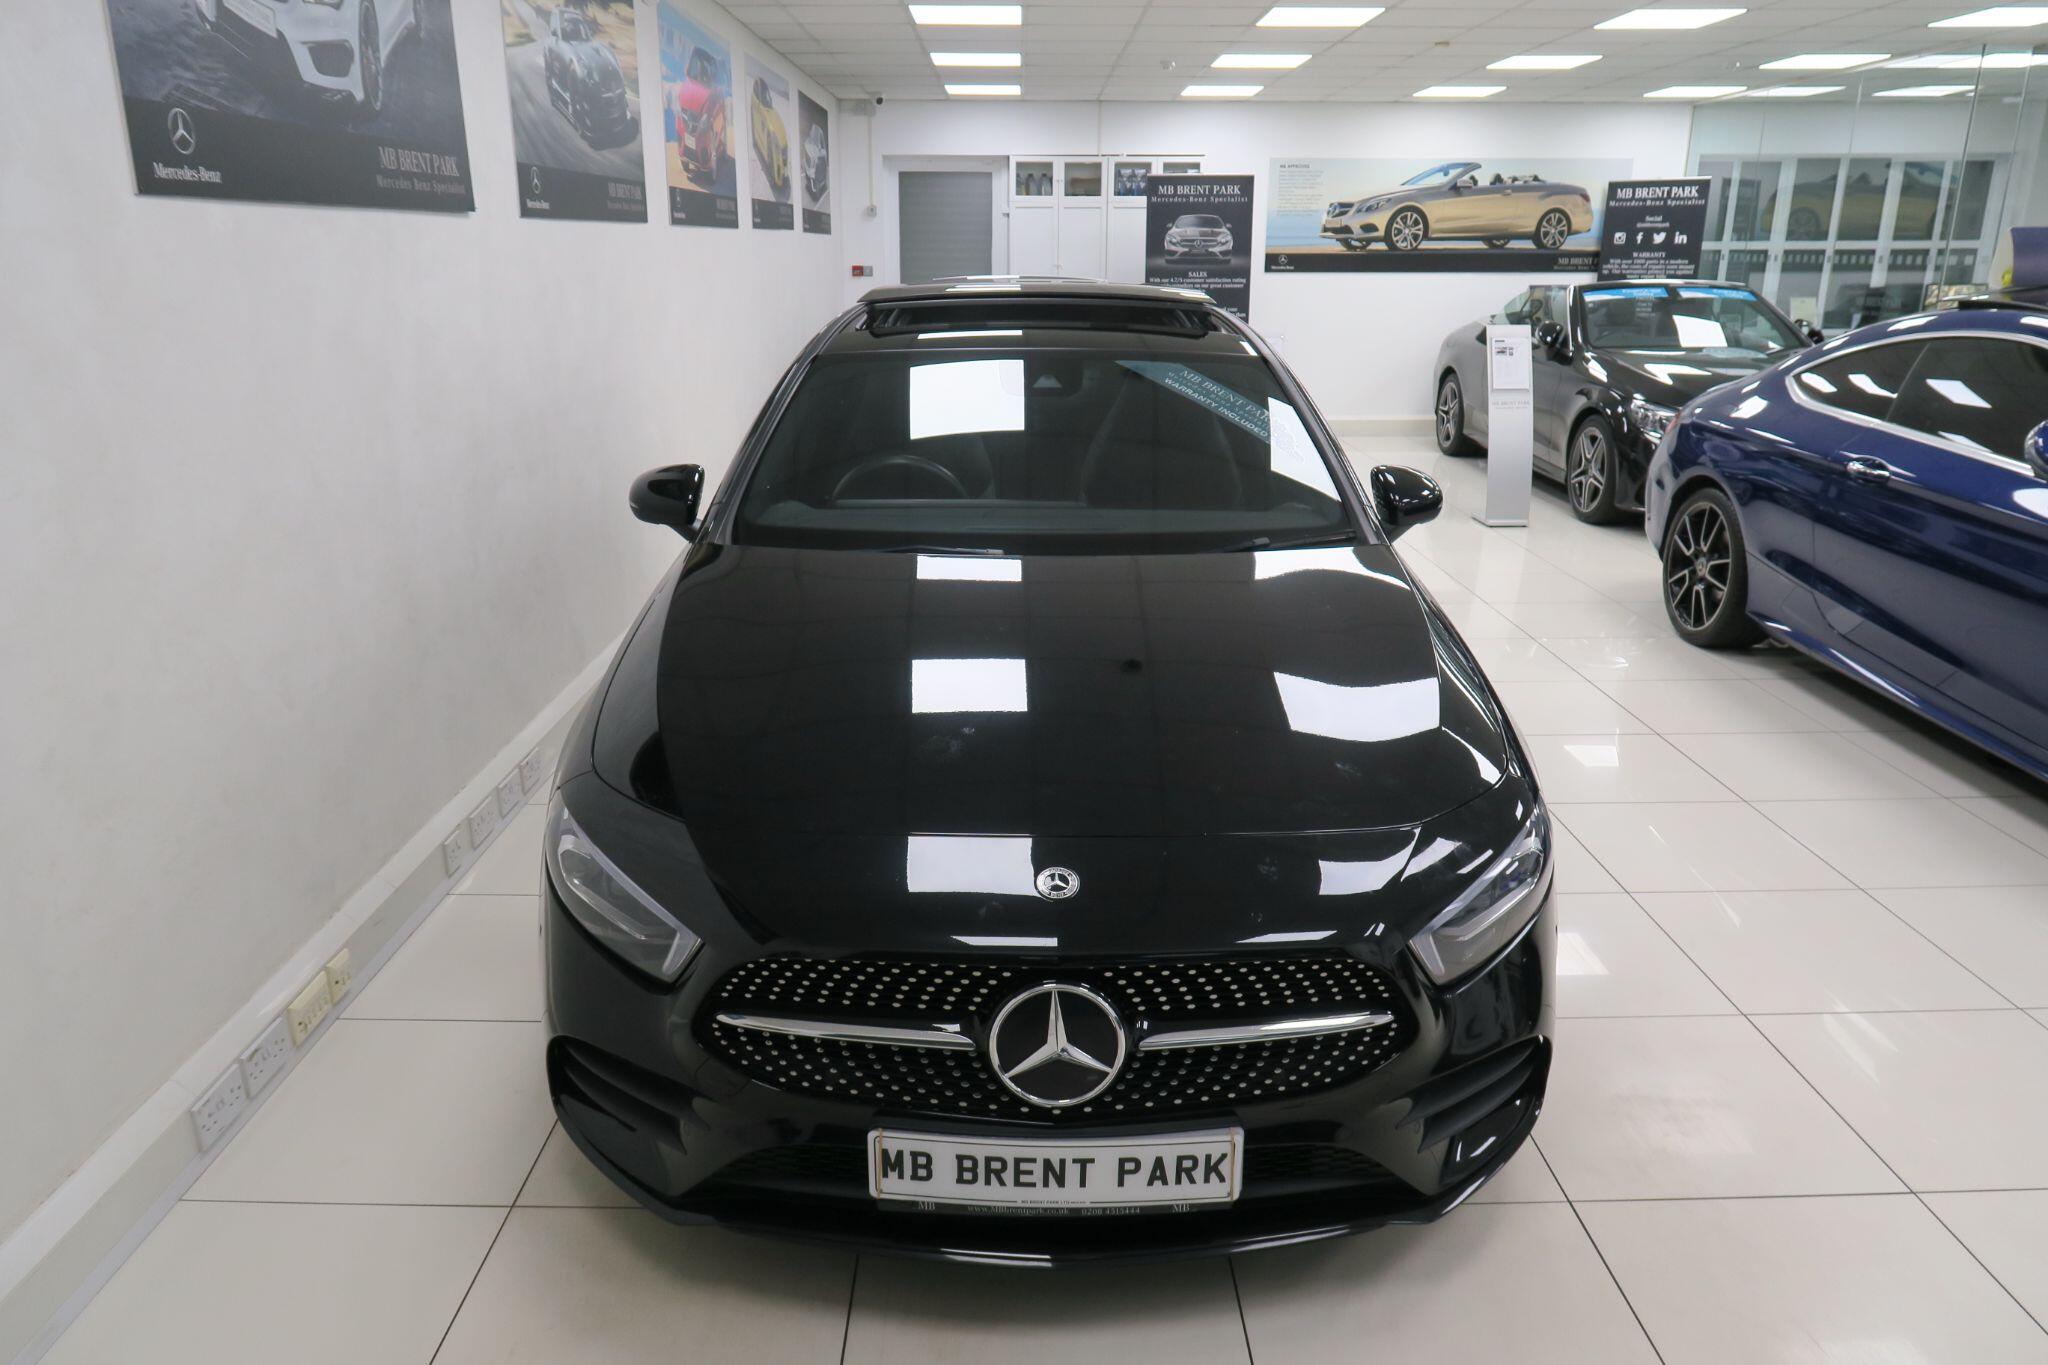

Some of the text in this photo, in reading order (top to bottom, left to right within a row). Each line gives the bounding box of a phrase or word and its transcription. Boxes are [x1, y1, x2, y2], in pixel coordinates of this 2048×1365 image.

[378, 146, 460, 177] MB BRENT PARK
[152, 162, 223, 184] Mercedes-Benz
[1158, 184, 1241, 195] MB BRENT PARK
[1616, 185, 1699, 199] MB BRENT PARK
[1210, 196, 1248, 204] Specialist
[1667, 198, 1705, 207] Specialist
[1181, 370, 1201, 384] MB
[1202, 381, 1246, 406] BRENT
[1165, 377, 1268, 437] WARRANTY INCLUDED
[881, 1148, 1229, 1188] MB BRENT PARK
[918, 1200, 936, 1210] MB
[1172, 1203, 1190, 1212] MB
